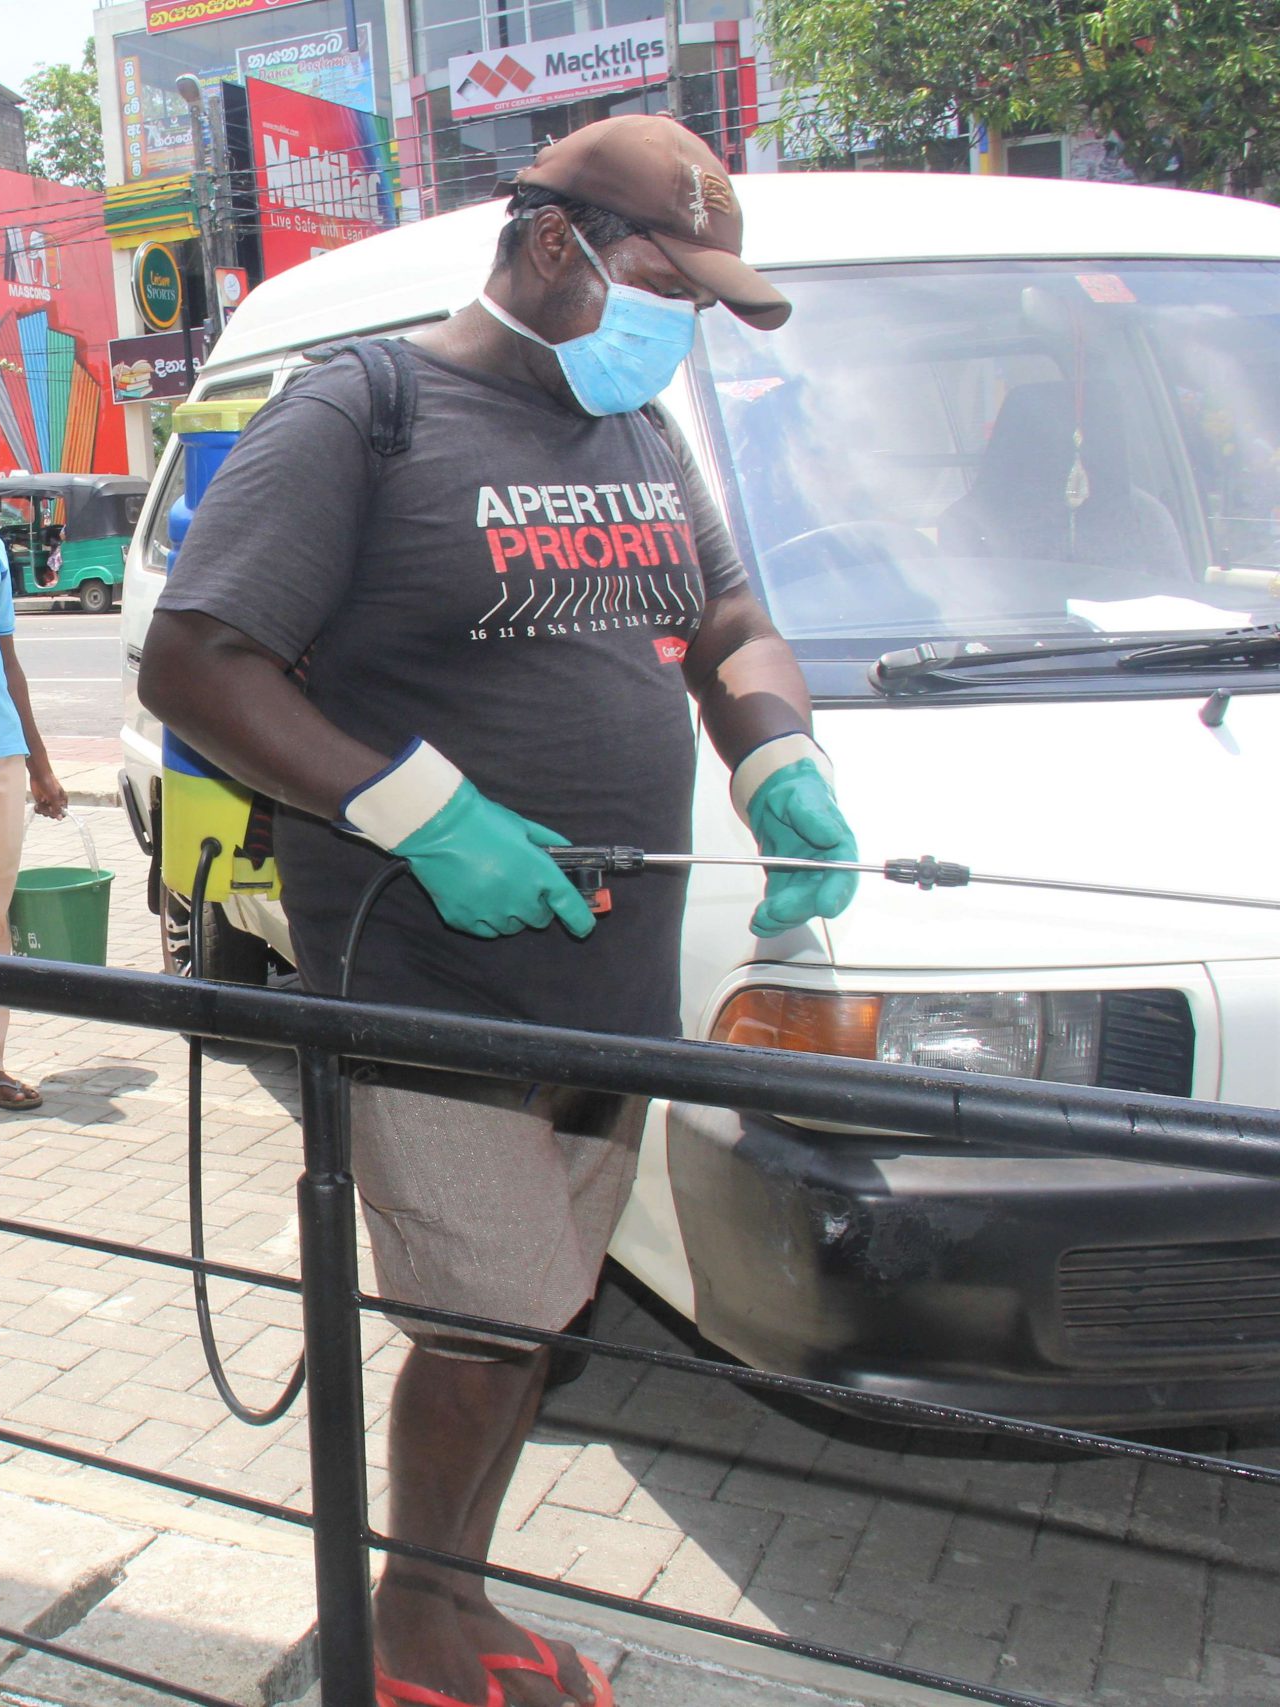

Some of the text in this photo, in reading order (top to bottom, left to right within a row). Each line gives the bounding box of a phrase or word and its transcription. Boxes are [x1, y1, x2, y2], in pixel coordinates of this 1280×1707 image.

[545, 38, 665, 77] Macktiles
[581, 65, 632, 82] LANKA
[494, 101, 510, 110] CITY
[263, 134, 384, 225] Multilac
[270, 213, 292, 229] Live
[294, 215, 318, 234] Safe
[320, 222, 339, 238] with
[8, 284, 51, 301] MASCONS
[146, 284, 177, 300] SPORTS
[476, 482, 686, 528] APERTURE
[486, 523, 699, 574] PRIORITY
[470, 629, 487, 640] 16
[499, 627, 515, 638] 11
[527, 625, 536, 637] 8
[547, 624, 567, 636] 5.6
[573, 622, 581, 633] 4
[590, 619, 607, 632] 2.8
[613, 618, 620, 629] 2
[625, 615, 639, 627] 2.8
[654, 614, 672, 625] 5.6
[675, 616, 686, 626] 8
